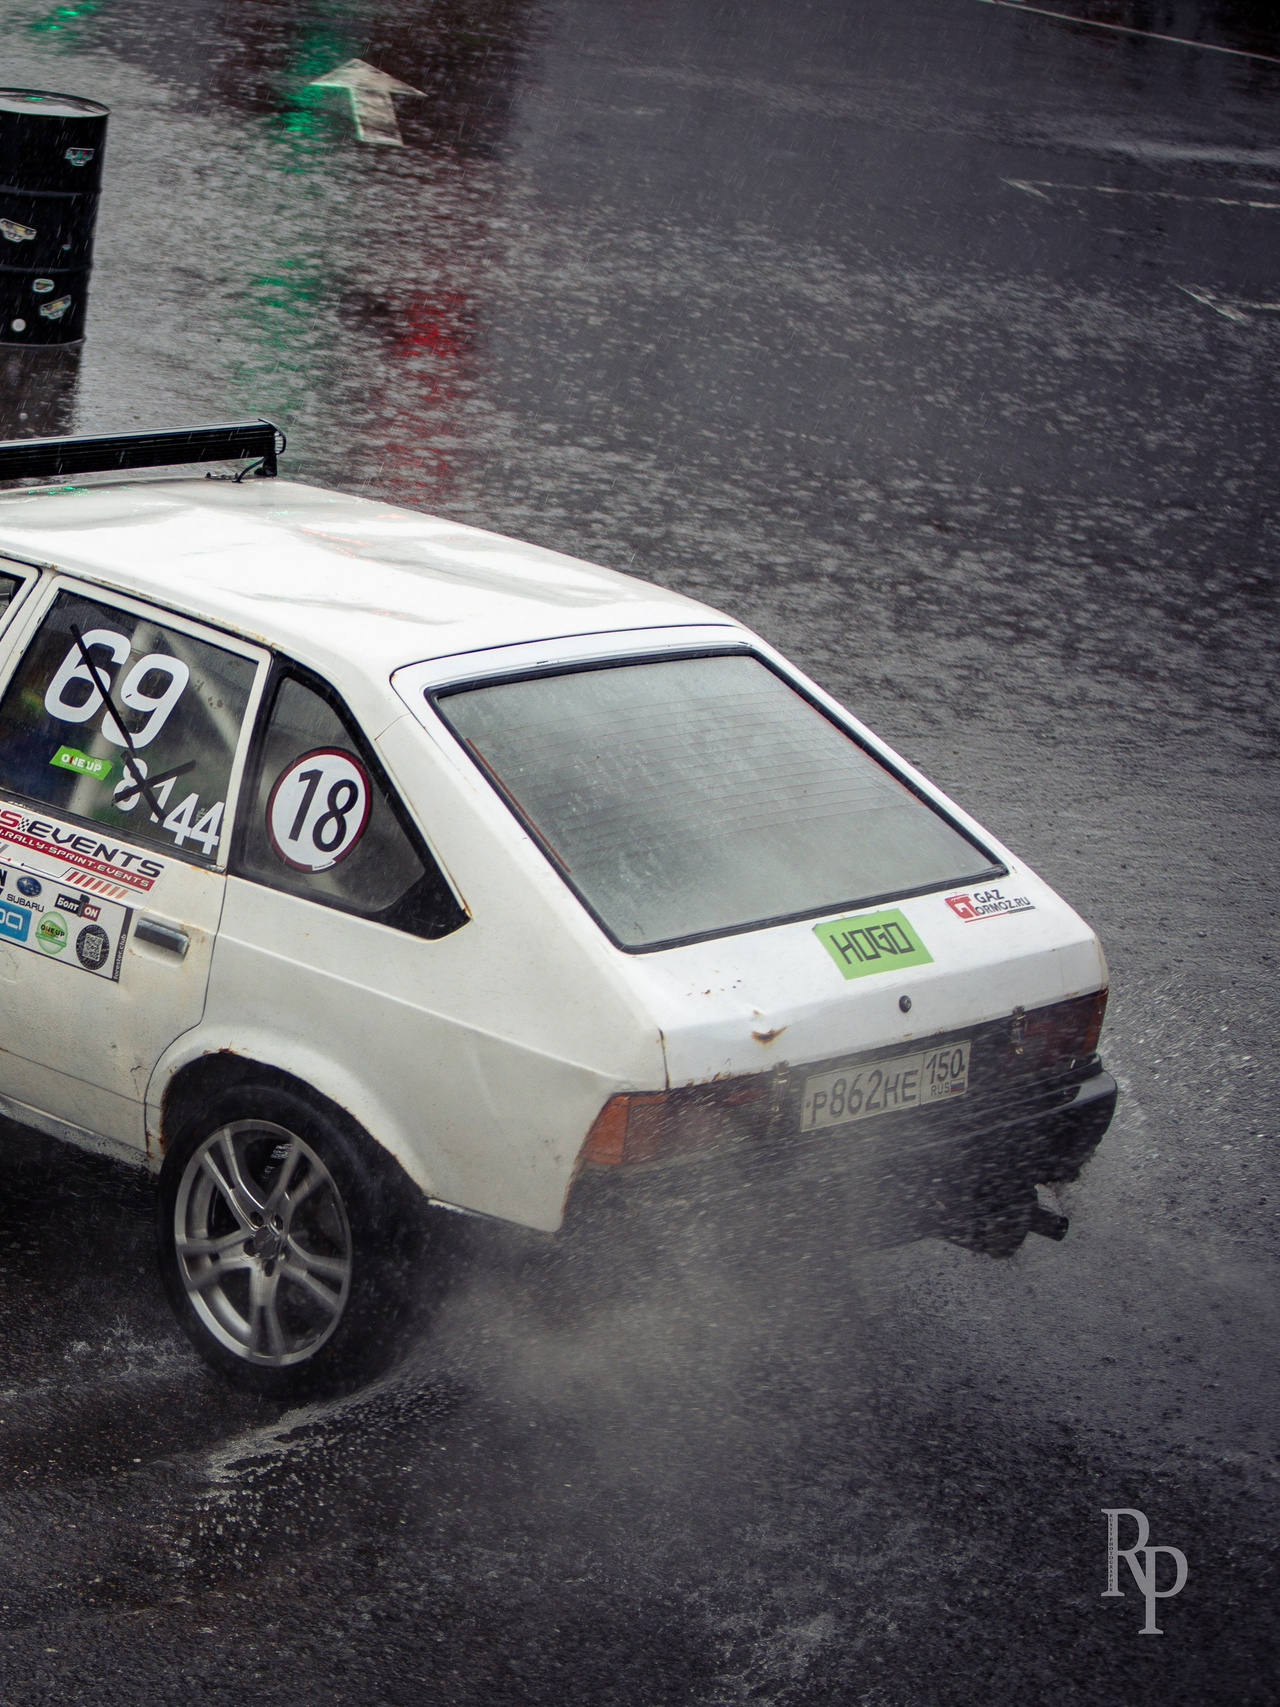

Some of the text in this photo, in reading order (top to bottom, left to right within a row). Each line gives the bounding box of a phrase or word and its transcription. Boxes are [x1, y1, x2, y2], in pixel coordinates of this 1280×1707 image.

[44, 629, 190, 749] 69
[61, 753, 102, 772] ONE UP
[288, 768, 359, 852] 18
[26, 820, 165, 879] EVENTS
[6, 893, 45, 913] SUBARU
[974, 889, 1005, 903] GAZ
[84, 907, 99, 918] ON
[829, 921, 916, 965] HOGO
[926, 1048, 963, 1085] 150
[930, 1082, 951, 1096] RUS
